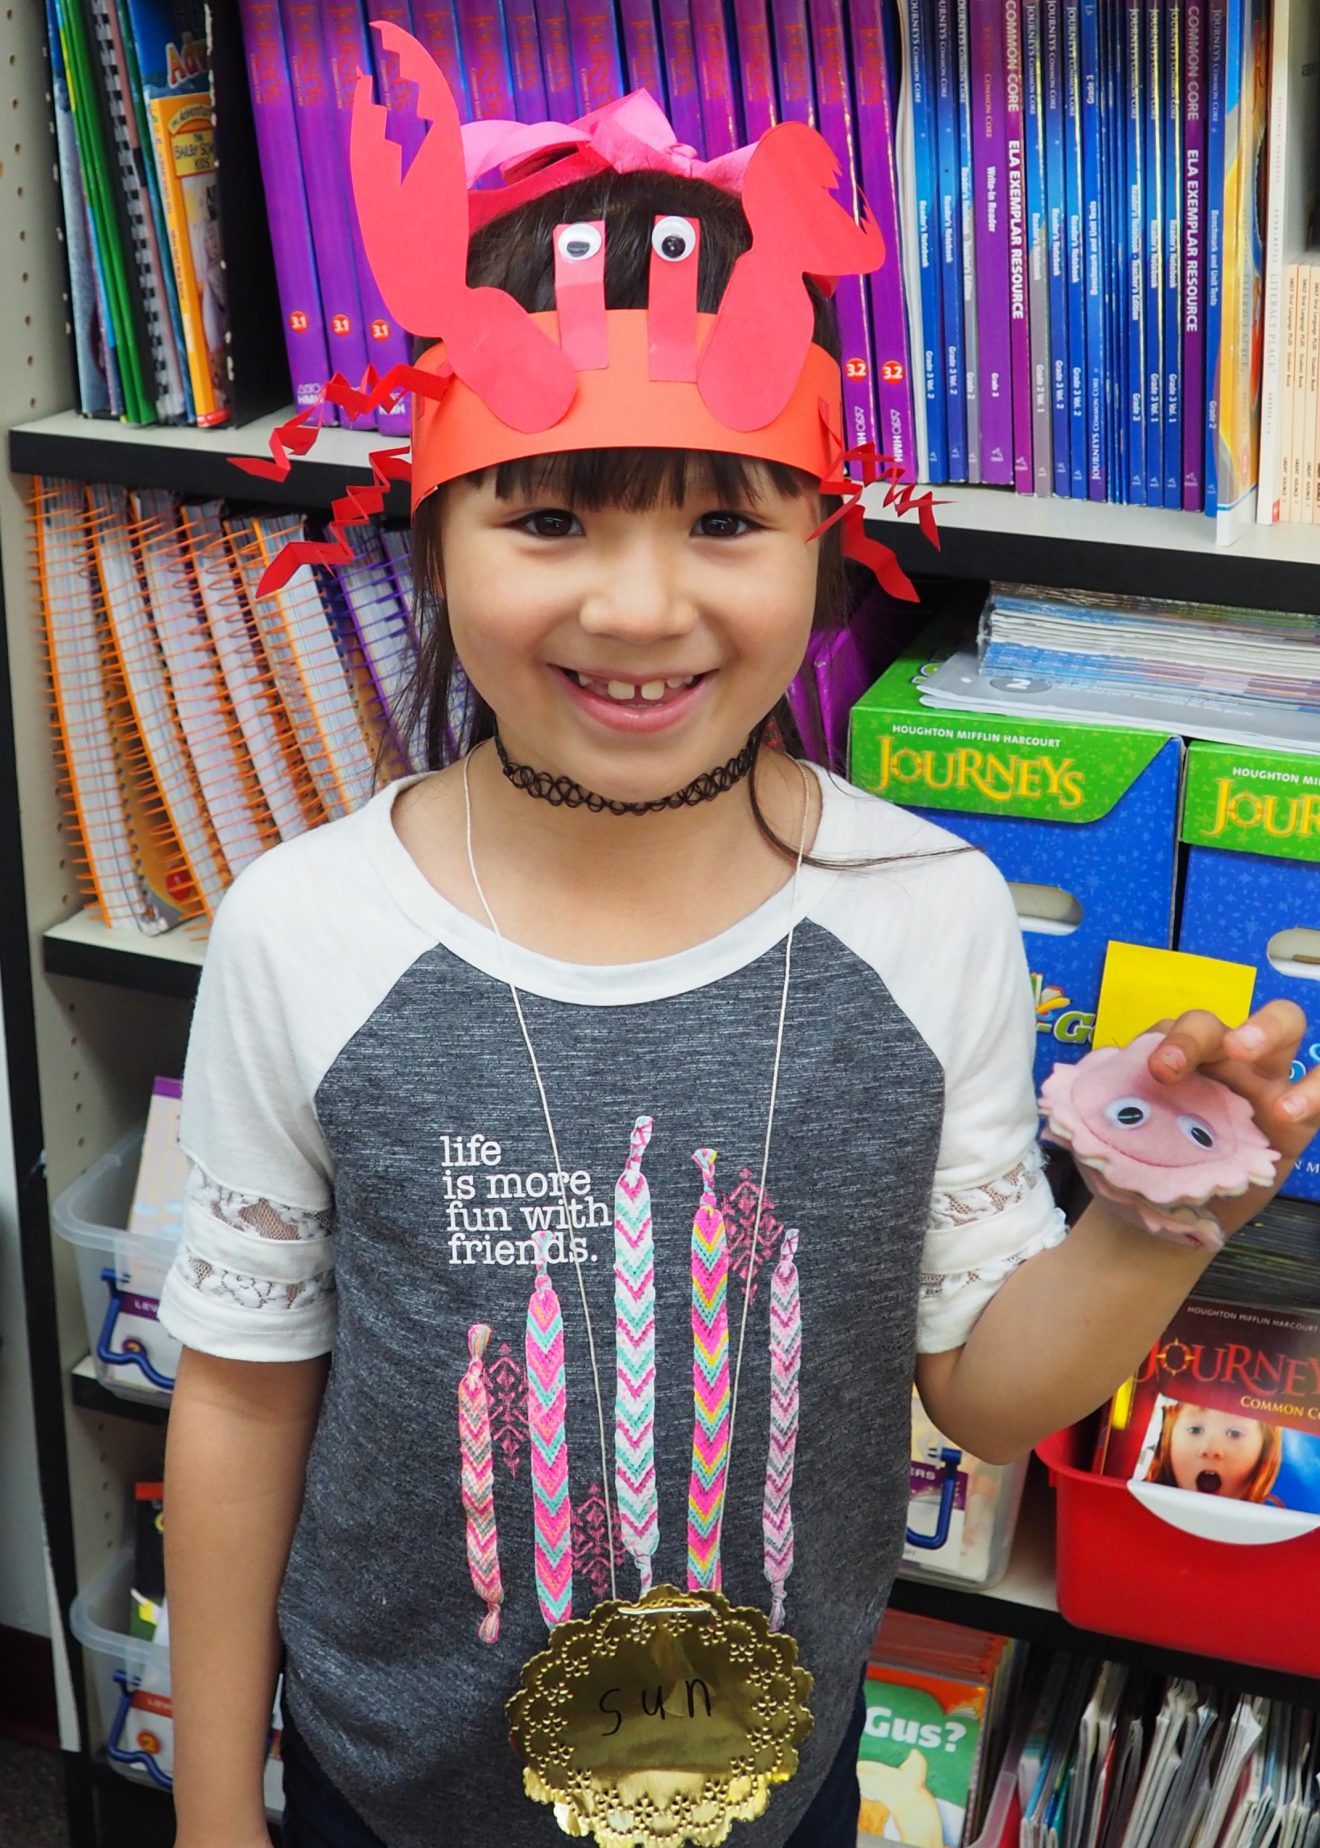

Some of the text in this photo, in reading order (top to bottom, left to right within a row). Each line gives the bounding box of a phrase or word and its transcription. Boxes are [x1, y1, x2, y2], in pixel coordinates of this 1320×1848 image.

[1005, 0, 1019, 112] COMMON CORE
[1187, 7, 1199, 120] COMMON CORE
[1087, 83, 1095, 104] Grade
[985, 116, 993, 138] CORE
[987, 167, 997, 232] Write-In Reader
[945, 229, 953, 262] Notebook
[1009, 141, 1023, 319] ELA EXEMPLAR RESOURCE
[1187, 150, 1198, 332] ELA EXEMPLAR RESOURCE
[921, 233, 929, 267] Notebook
[1053, 241, 1061, 276] Notebook
[1071, 248, 1079, 283] Notebook
[1210, 210, 1219, 306] Benchmark and Unit Tests
[926, 351, 934, 371] Grade
[949, 346, 957, 367] Grade
[1055, 360, 1064, 381] Grade
[967, 372, 975, 392] Grade
[1036, 364, 1044, 386] Grade
[1073, 367, 1081, 388] Grade
[1150, 373, 1158, 394] Grade
[1169, 373, 1177, 395] Grade
[1132, 393, 1140, 414] Grade
[1209, 401, 1217, 422] Grade
[1091, 433, 1101, 479] JOURNEYS
[892, 724, 1061, 748] HOUGHTON MIFFLIN HARCOURT
[870, 733, 1086, 808] JOURNEYS
[1231, 766, 1300, 784] HOUGHTON
[439, 1134, 502, 1167] life
[443, 1169, 592, 1200] is more
[446, 1196, 613, 1231] fun with
[448, 1232, 598, 1265] friends.
[1187, 1305, 1318, 1333] HOUGHTON MIFFLIN HARCOURT
[1240, 1395, 1304, 1416] COMMON
[599, 1678, 712, 1737] sun
[864, 1706, 967, 1753] Gus?
